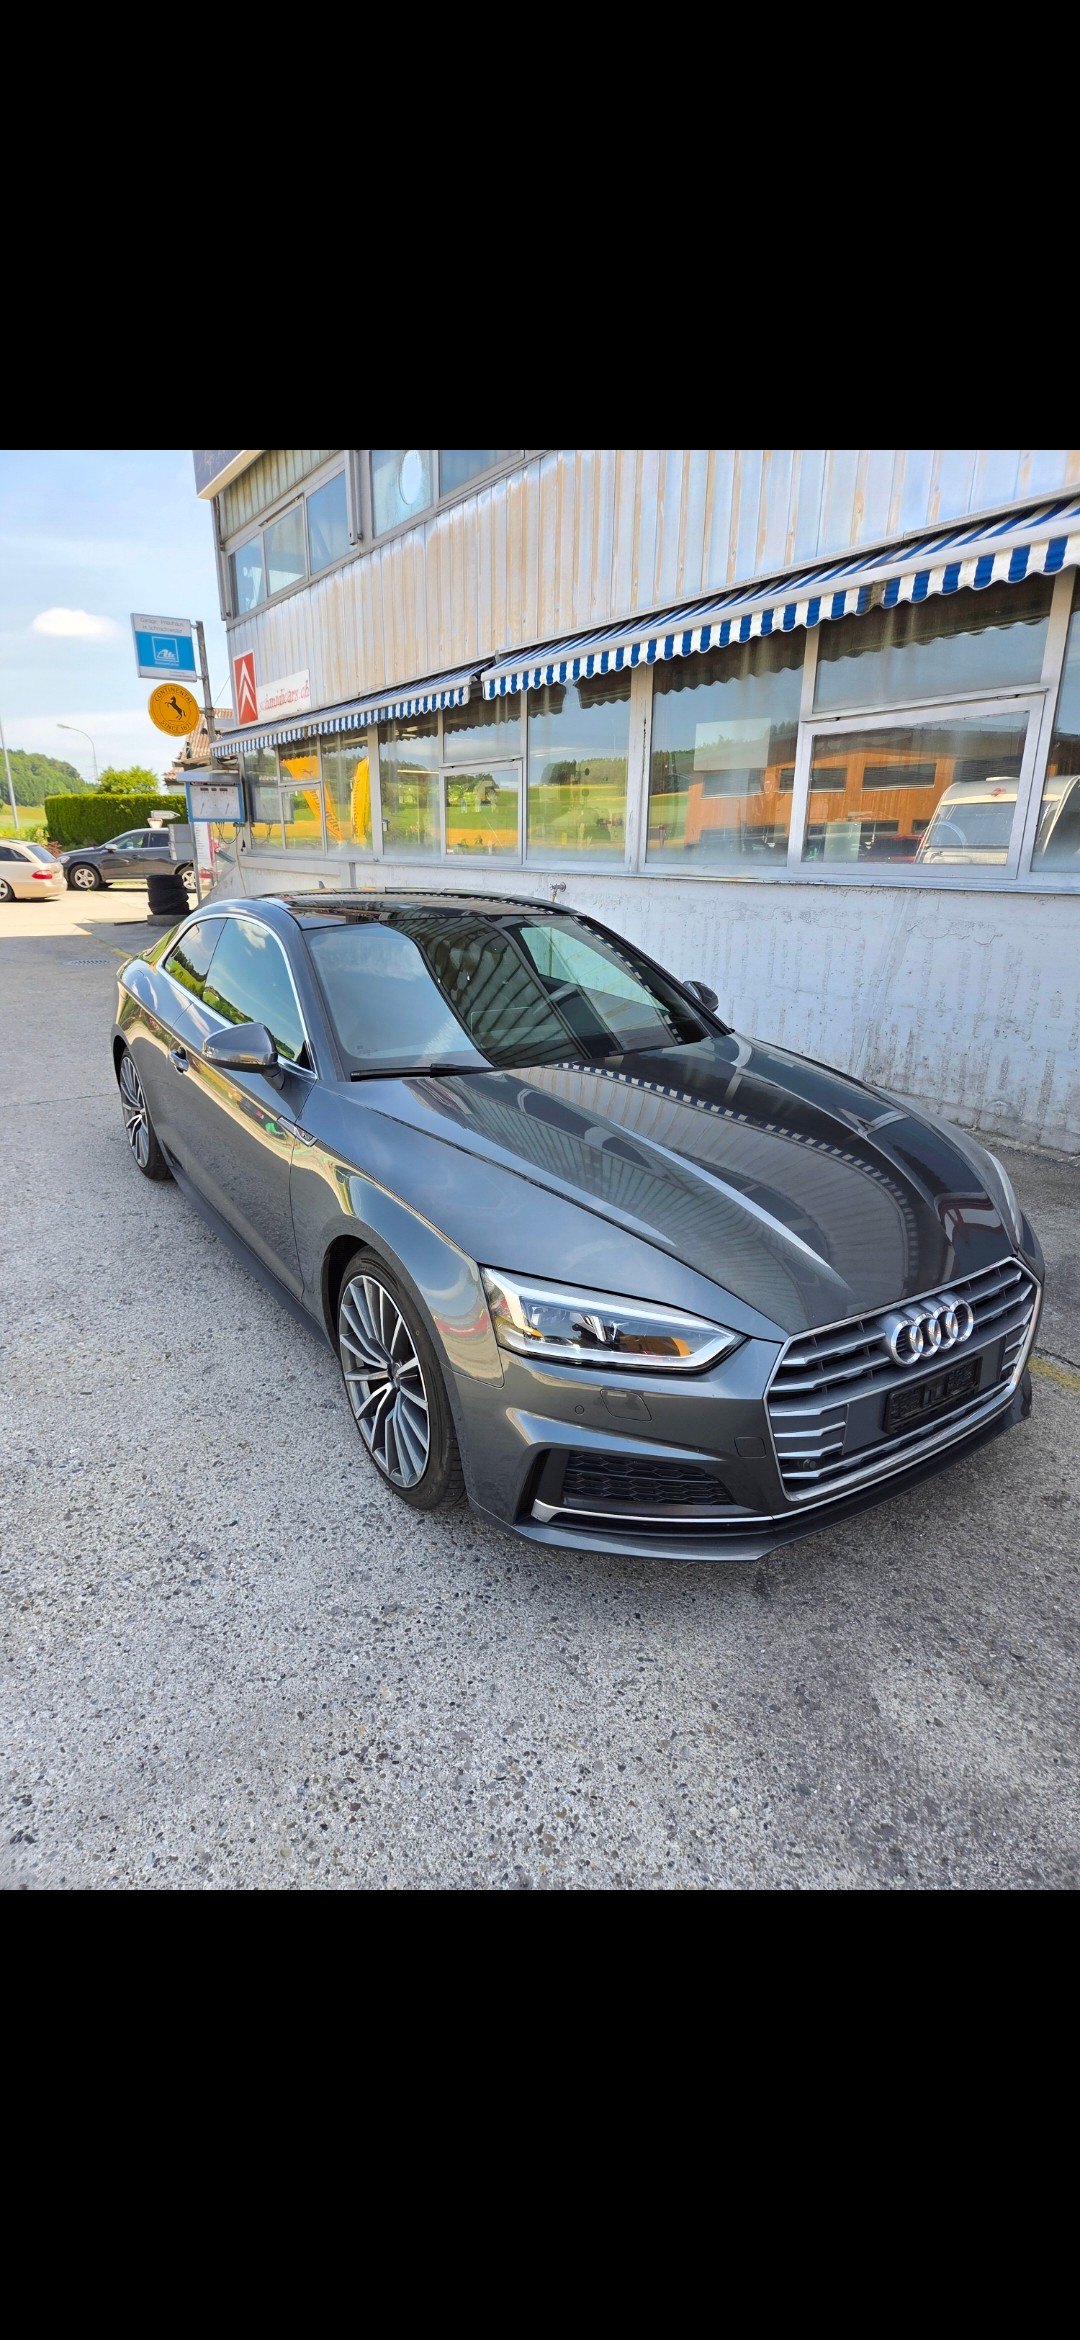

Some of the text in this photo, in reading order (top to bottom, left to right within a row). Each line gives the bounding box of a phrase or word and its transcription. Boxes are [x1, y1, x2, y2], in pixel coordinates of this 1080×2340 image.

[155, 687, 193, 704] CONTINENTAL
[160, 720, 192, 731] SINCE 1871
